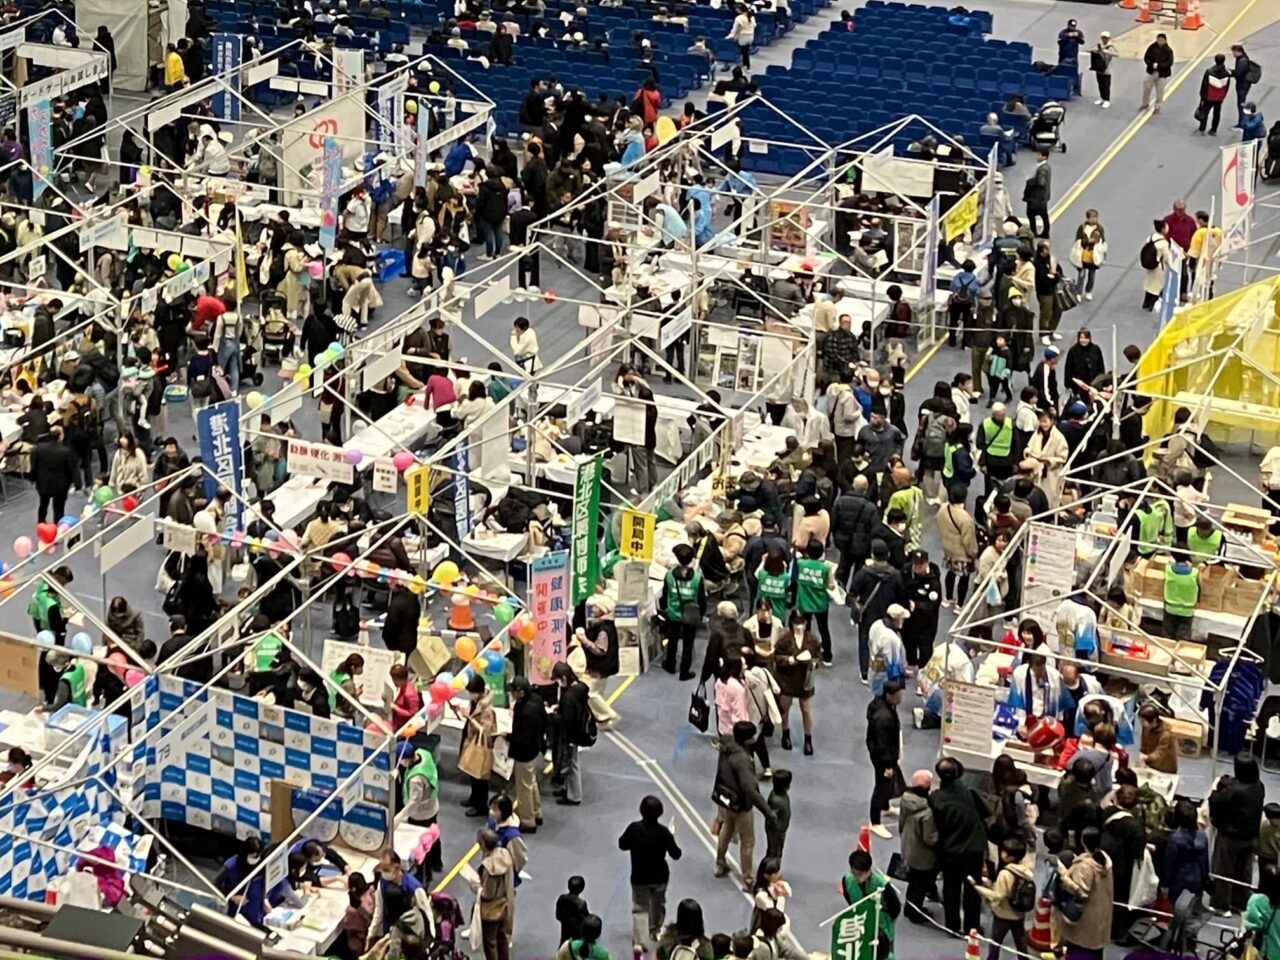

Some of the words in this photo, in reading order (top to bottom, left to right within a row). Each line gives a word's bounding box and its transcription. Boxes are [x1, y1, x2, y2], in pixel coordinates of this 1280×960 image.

[630, 515, 645, 553] 開局中
[158, 745, 171, 763] 79
